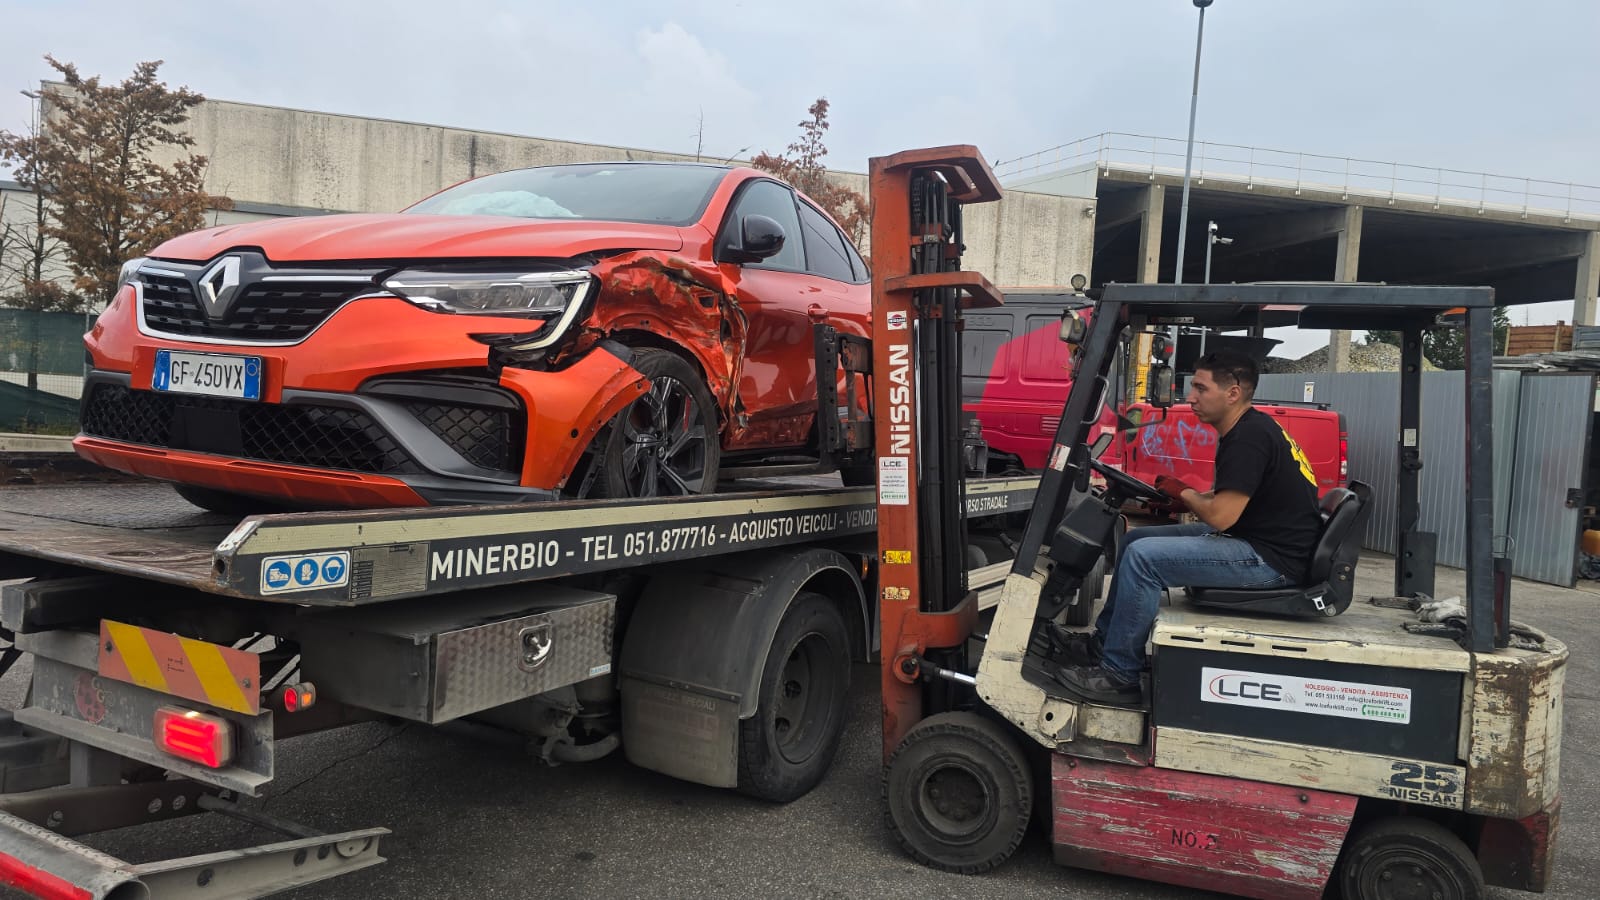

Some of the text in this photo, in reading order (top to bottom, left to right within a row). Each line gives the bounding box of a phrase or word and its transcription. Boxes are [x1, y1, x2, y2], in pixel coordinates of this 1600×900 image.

[889, 344, 911, 454] NISSAN
[431, 540, 559, 581] MINERBIO
[581, 535, 618, 562] TEL
[624, 525, 716, 557] 051.877716
[729, 516, 793, 543] ACQUISTO
[796, 512, 838, 534] VEICOLI
[980, 495, 1008, 511] STRADALE
[1218, 679, 1282, 702] LCE
[1304, 683, 1336, 692] NOLEGGIO
[1341, 687, 1367, 695] VENDITA
[1371, 690, 1409, 700] ASSISTENZA
[1390, 762, 1457, 794] 25
[1389, 787, 1457, 808] NISSAN
